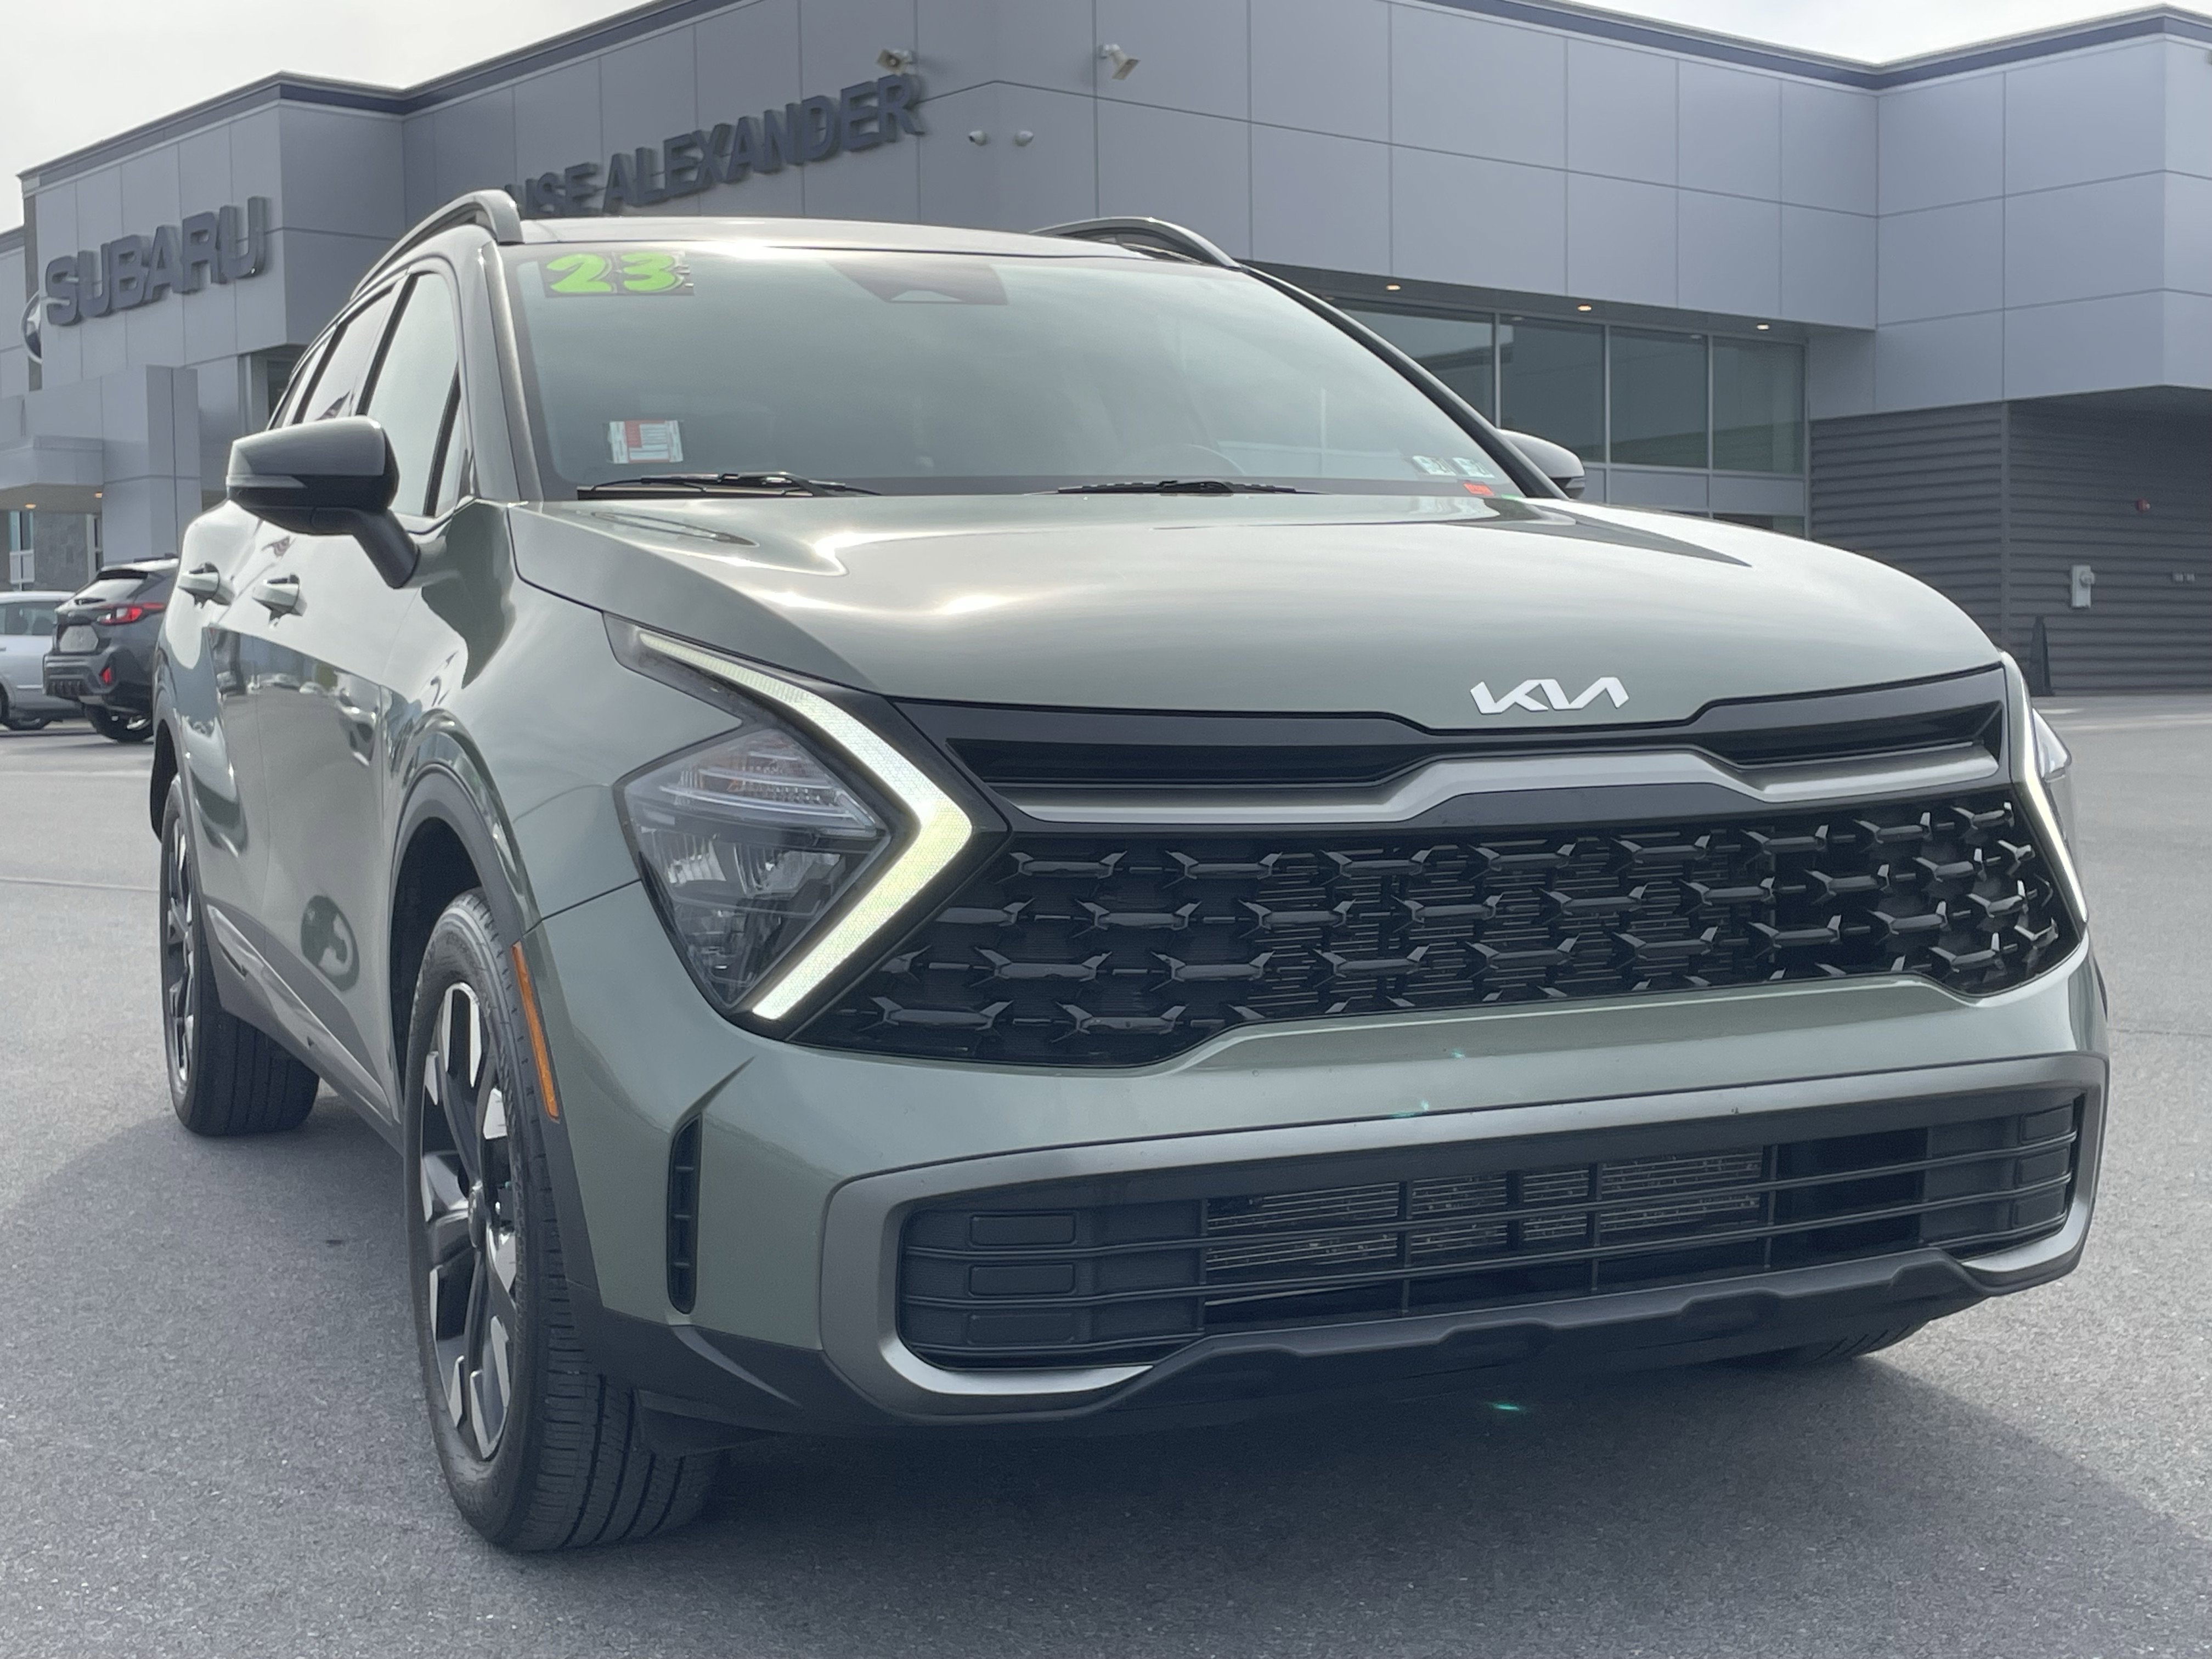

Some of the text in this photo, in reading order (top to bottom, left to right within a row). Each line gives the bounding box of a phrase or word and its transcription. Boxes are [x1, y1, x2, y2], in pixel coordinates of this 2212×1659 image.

[603, 74, 925, 215] ALEXANDER
[46, 196, 267, 326] SUBARU
[546, 252, 682, 294] 23
[1470, 677, 1629, 714] KIA
